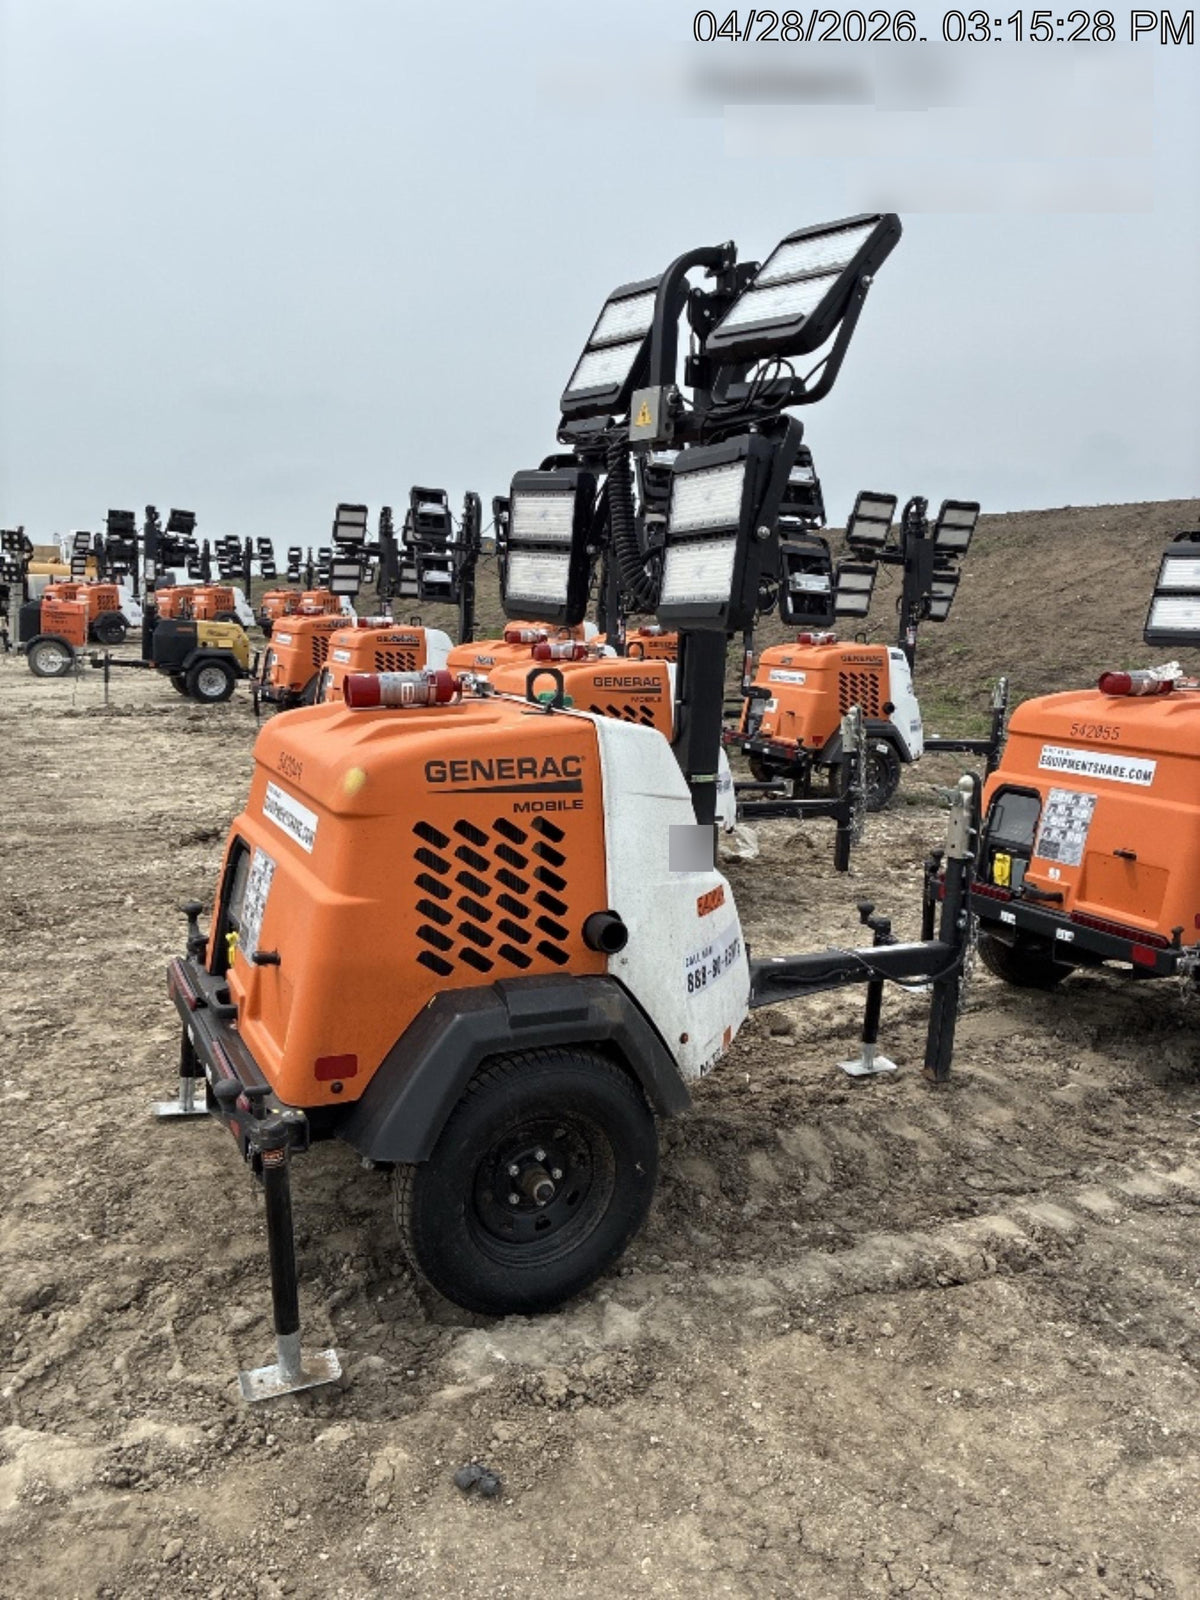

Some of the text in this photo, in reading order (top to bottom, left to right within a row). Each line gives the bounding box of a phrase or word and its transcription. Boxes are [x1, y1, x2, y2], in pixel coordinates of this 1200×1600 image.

[593, 676, 662, 687] GENERAC
[1070, 723, 1121, 741] 542055
[424, 755, 583, 783] GENERAC
[1040, 754, 1153, 782] EQUIPMENTSHARE.COM
[513, 799, 584, 813] MOBILE
